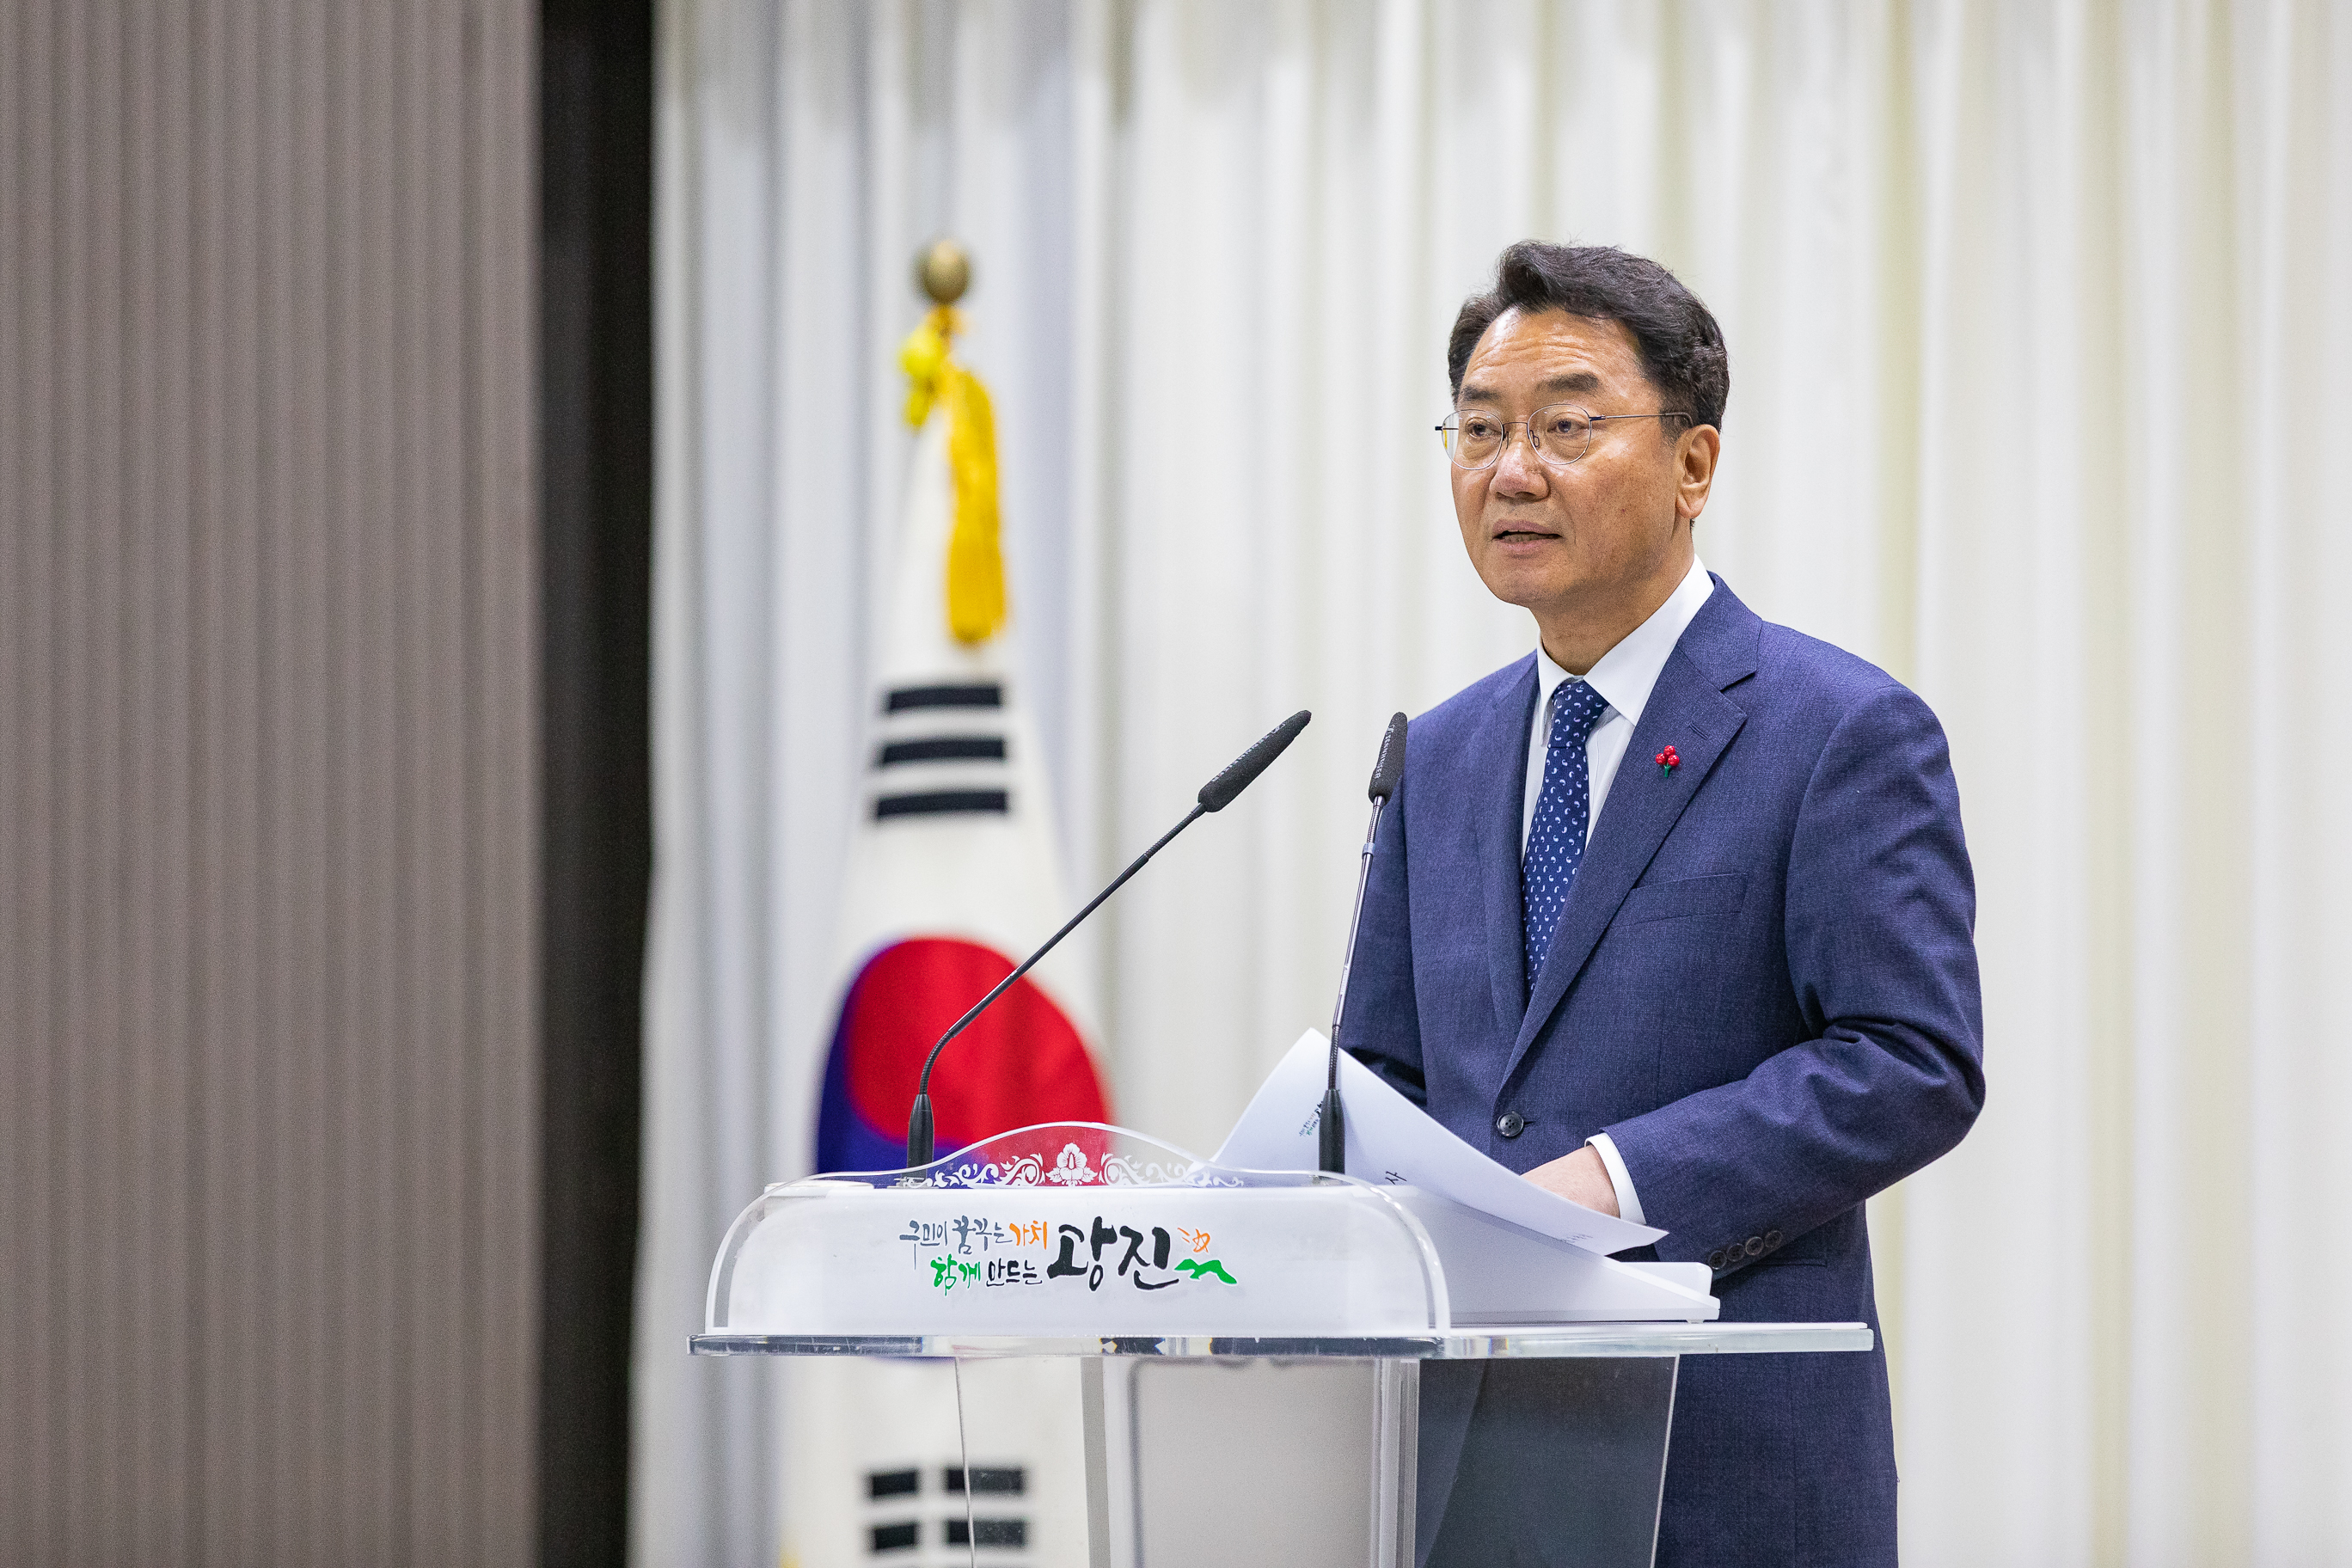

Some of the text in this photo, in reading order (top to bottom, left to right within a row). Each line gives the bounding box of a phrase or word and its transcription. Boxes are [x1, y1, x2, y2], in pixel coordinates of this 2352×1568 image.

[898, 1215, 1048, 1271] 구민이 꿈꾸는 가치
[1046, 1216, 1180, 1292] 광진
[930, 1253, 1043, 1296] 함께 만드는
